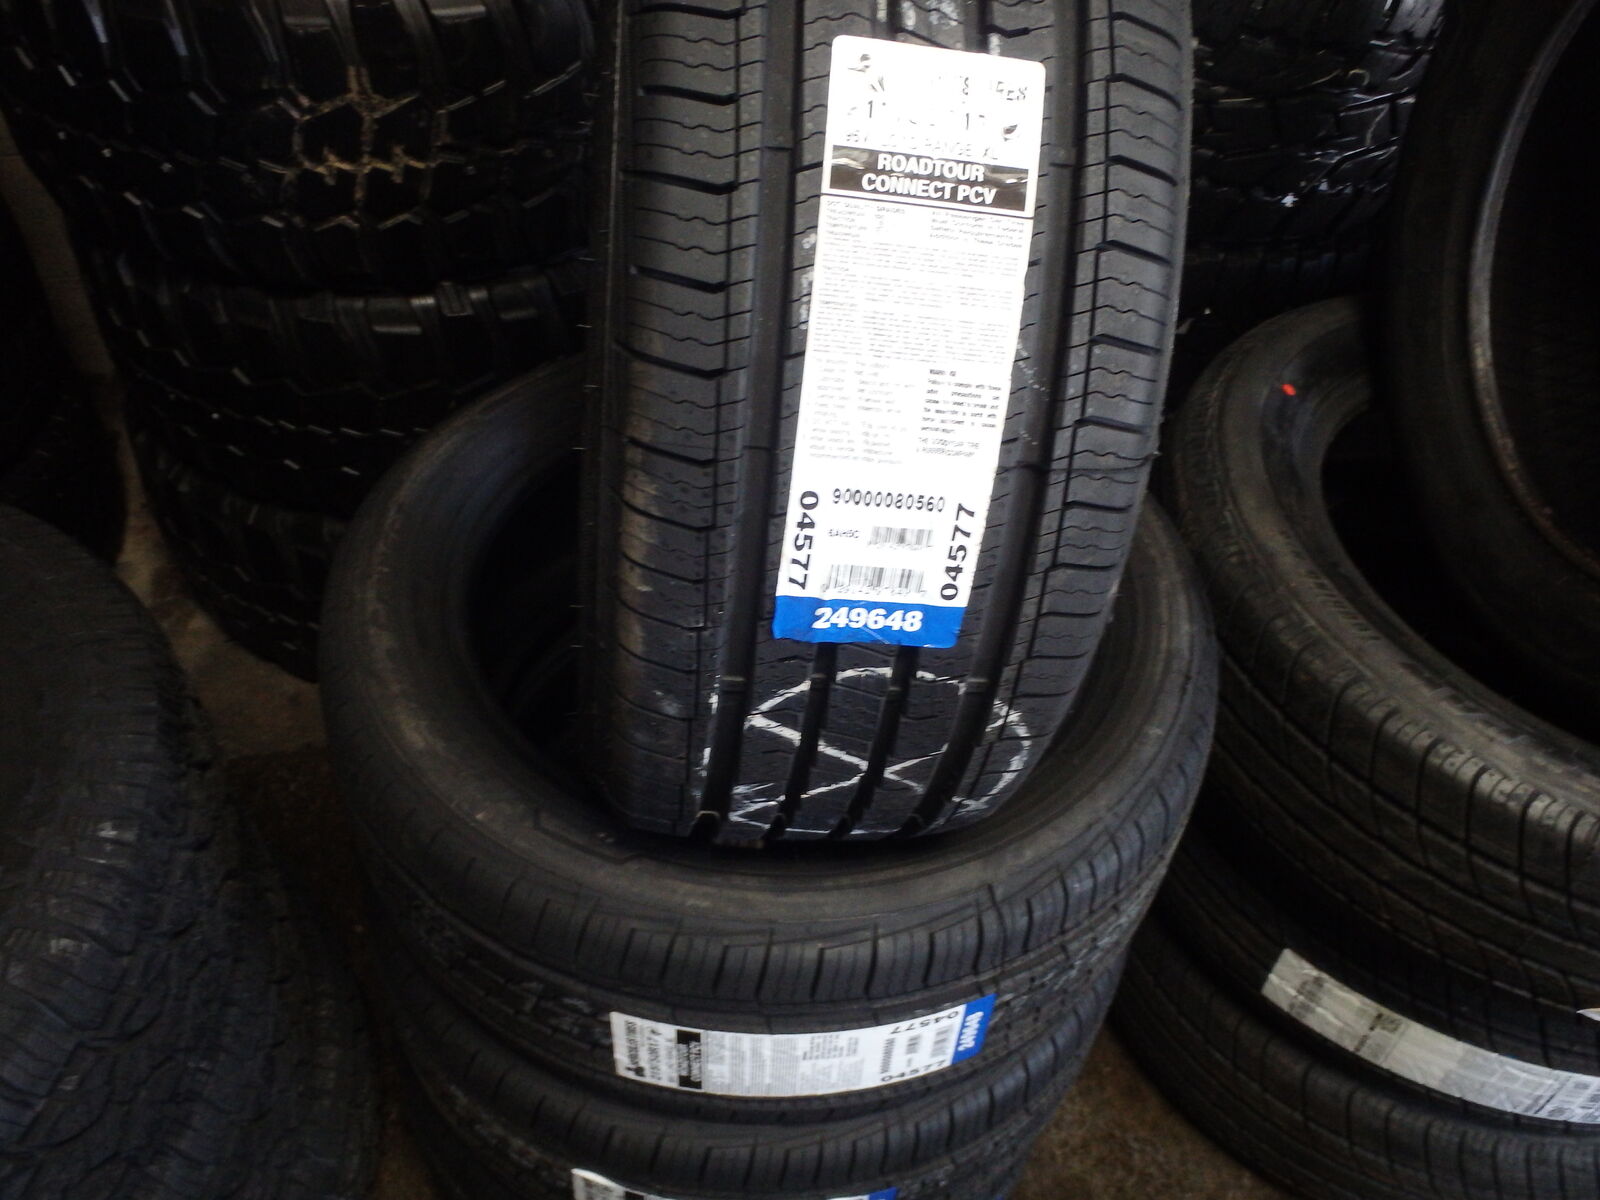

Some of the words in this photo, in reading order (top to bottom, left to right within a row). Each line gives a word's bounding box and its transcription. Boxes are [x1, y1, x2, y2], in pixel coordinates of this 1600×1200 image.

[877, 153, 985, 182] ROADTOUR
[861, 173, 957, 200] CONNECT
[956, 182, 997, 205] PCV
[832, 488, 945, 513] 90000080560
[788, 490, 819, 590] 04577
[940, 503, 975, 601] 04577
[811, 607, 924, 632] 249648
